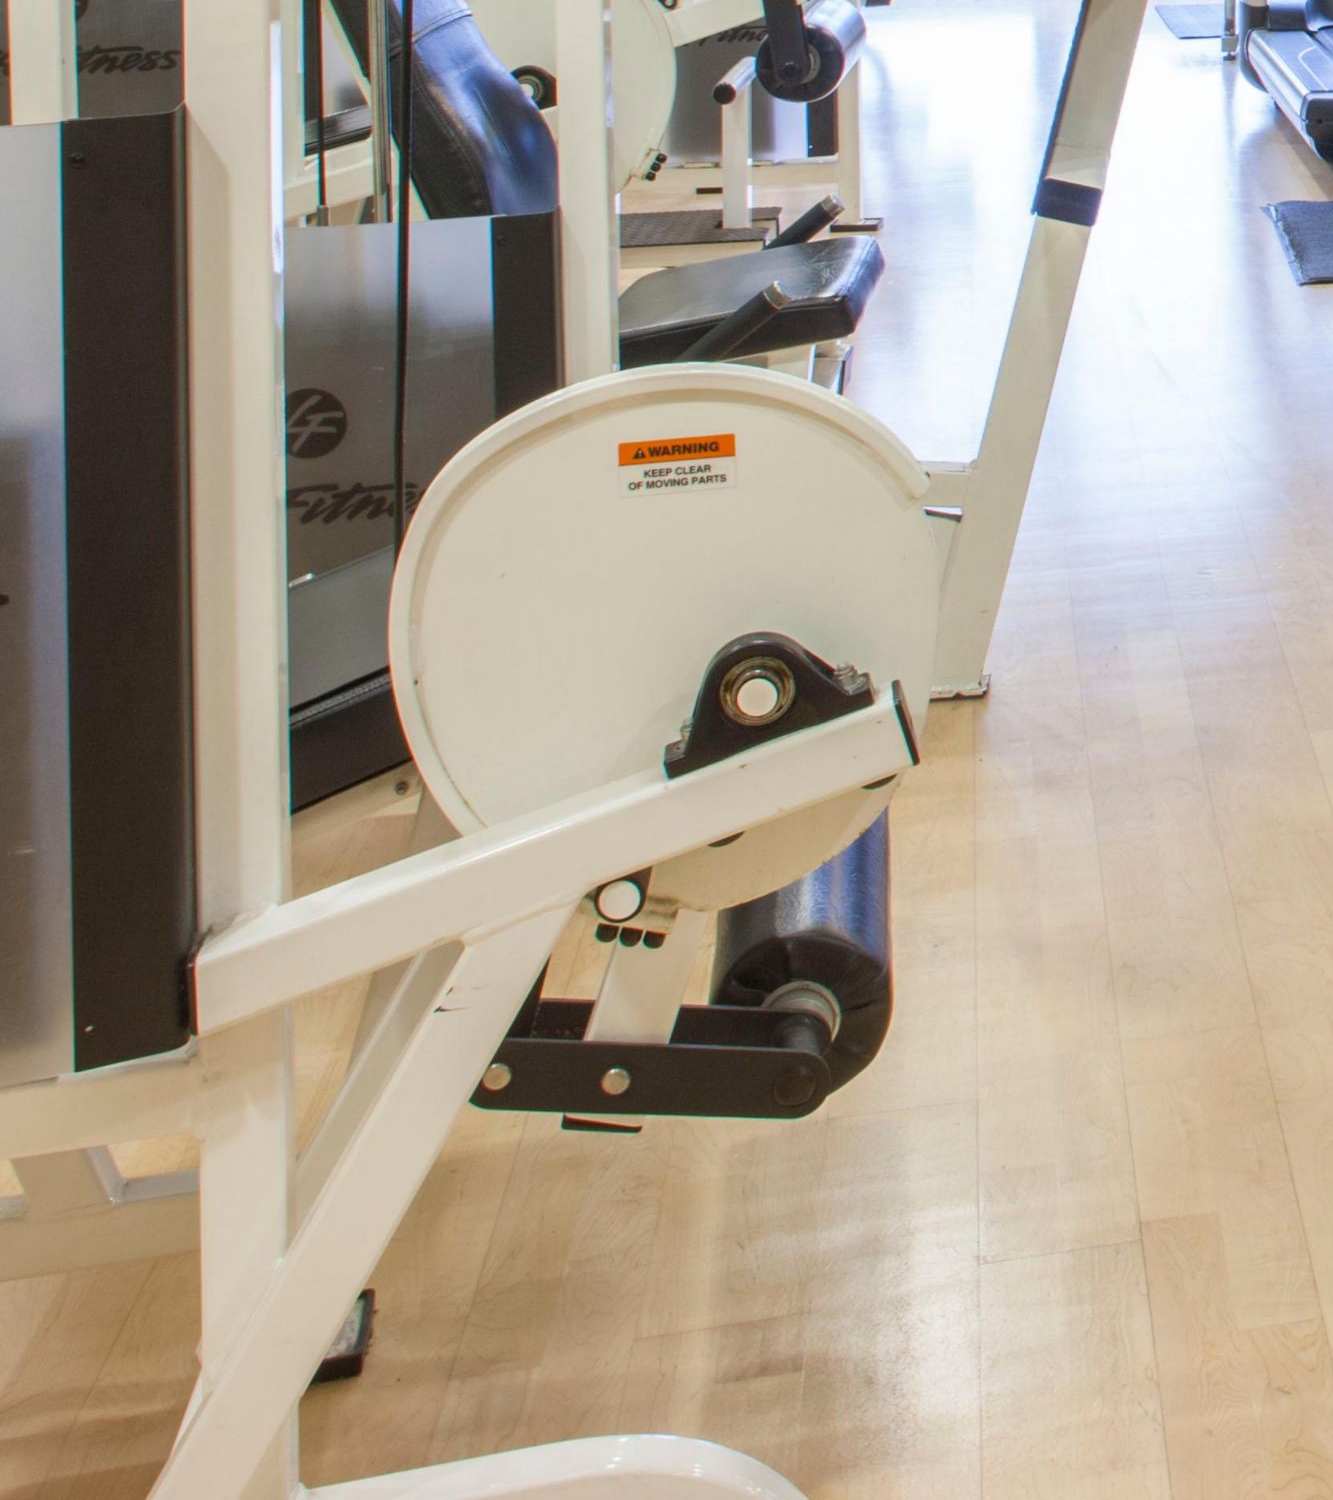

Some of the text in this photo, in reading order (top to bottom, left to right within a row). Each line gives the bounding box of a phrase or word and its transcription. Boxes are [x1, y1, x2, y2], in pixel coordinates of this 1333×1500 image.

[648, 441, 719, 457] WARNING
[643, 464, 711, 478] KEEP CLEAR
[628, 474, 728, 491] OF MOVING PARTS
